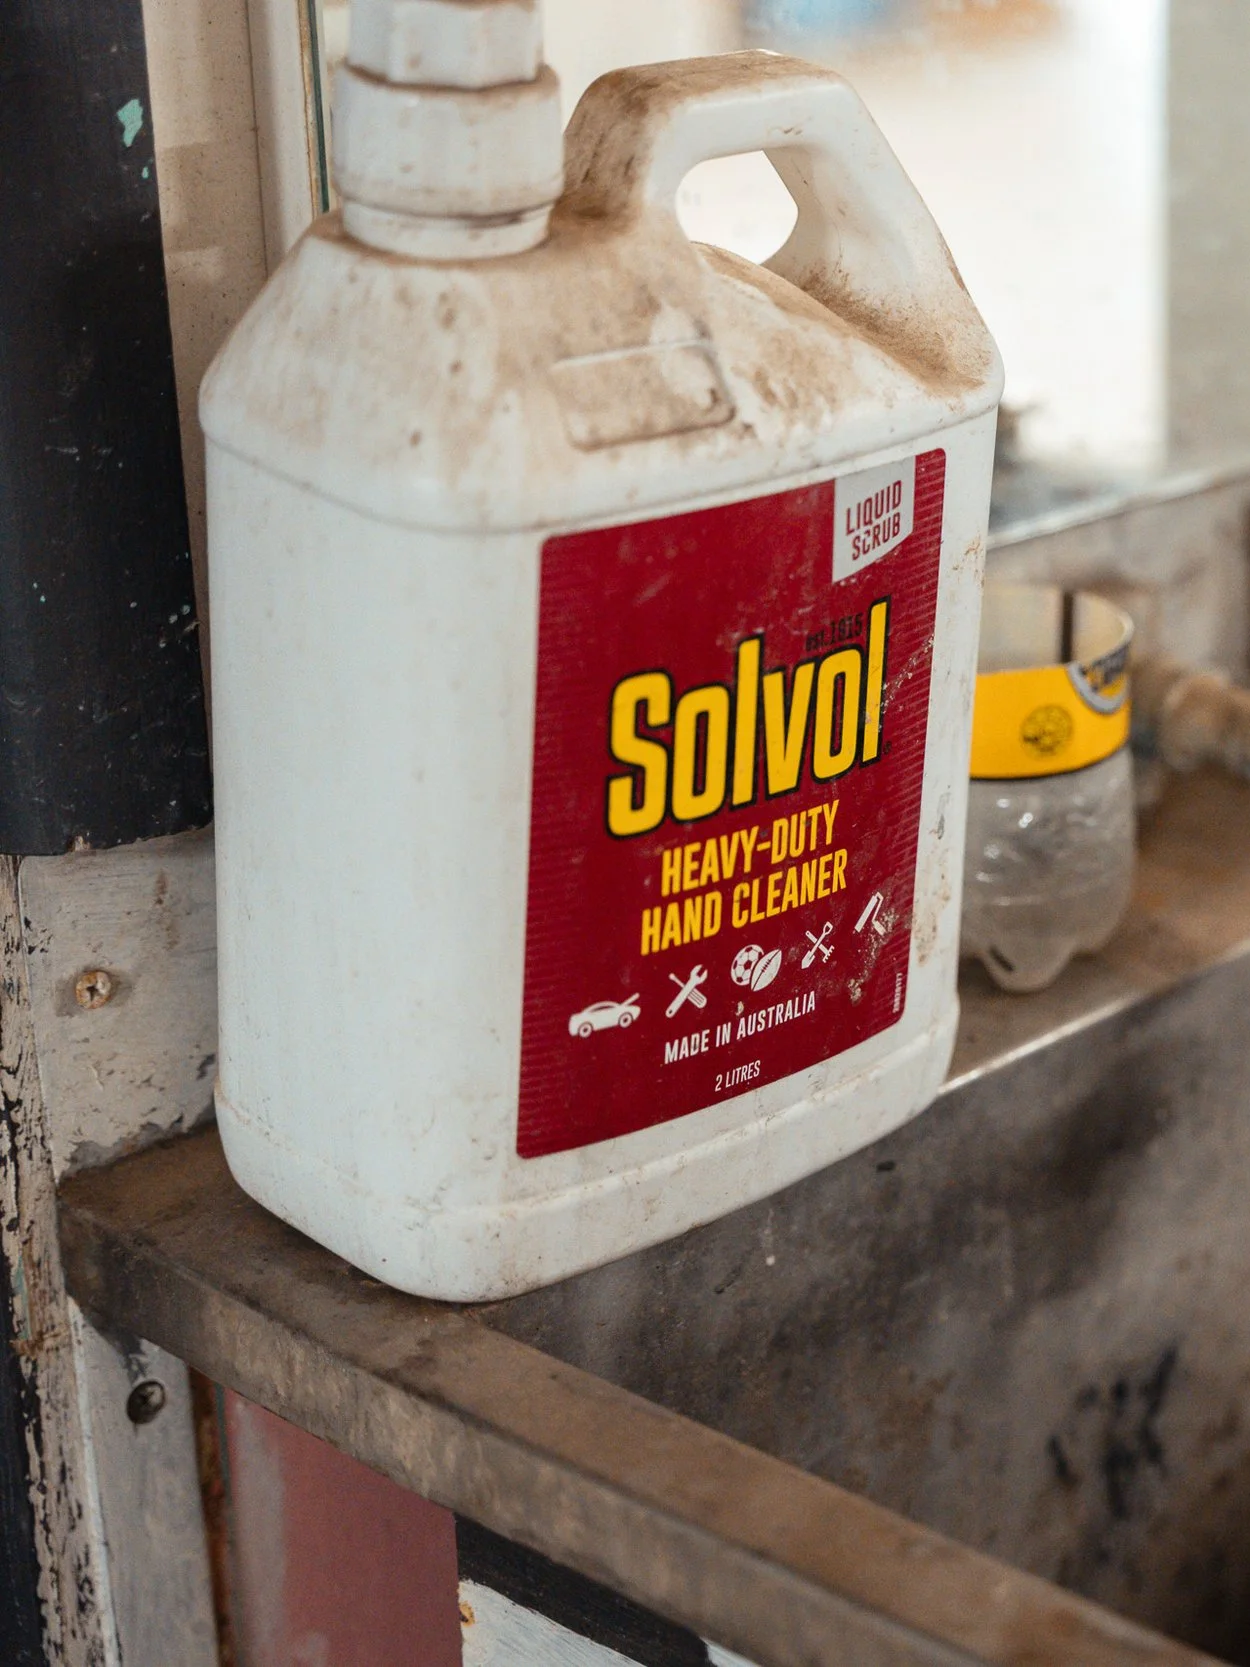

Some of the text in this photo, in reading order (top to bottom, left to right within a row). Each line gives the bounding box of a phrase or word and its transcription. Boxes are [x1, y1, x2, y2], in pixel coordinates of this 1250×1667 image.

[845, 480, 902, 536] LIQUID
[851, 514, 901, 561] SCRUB
[606, 595, 891, 837] Solvol
[661, 800, 840, 897] HEAVY-DUTY
[640, 848, 848, 956] HAND CLEANER
[664, 991, 816, 1064] MADE IN AUSTRALIA
[714, 1060, 761, 1092] 2 LITRES
